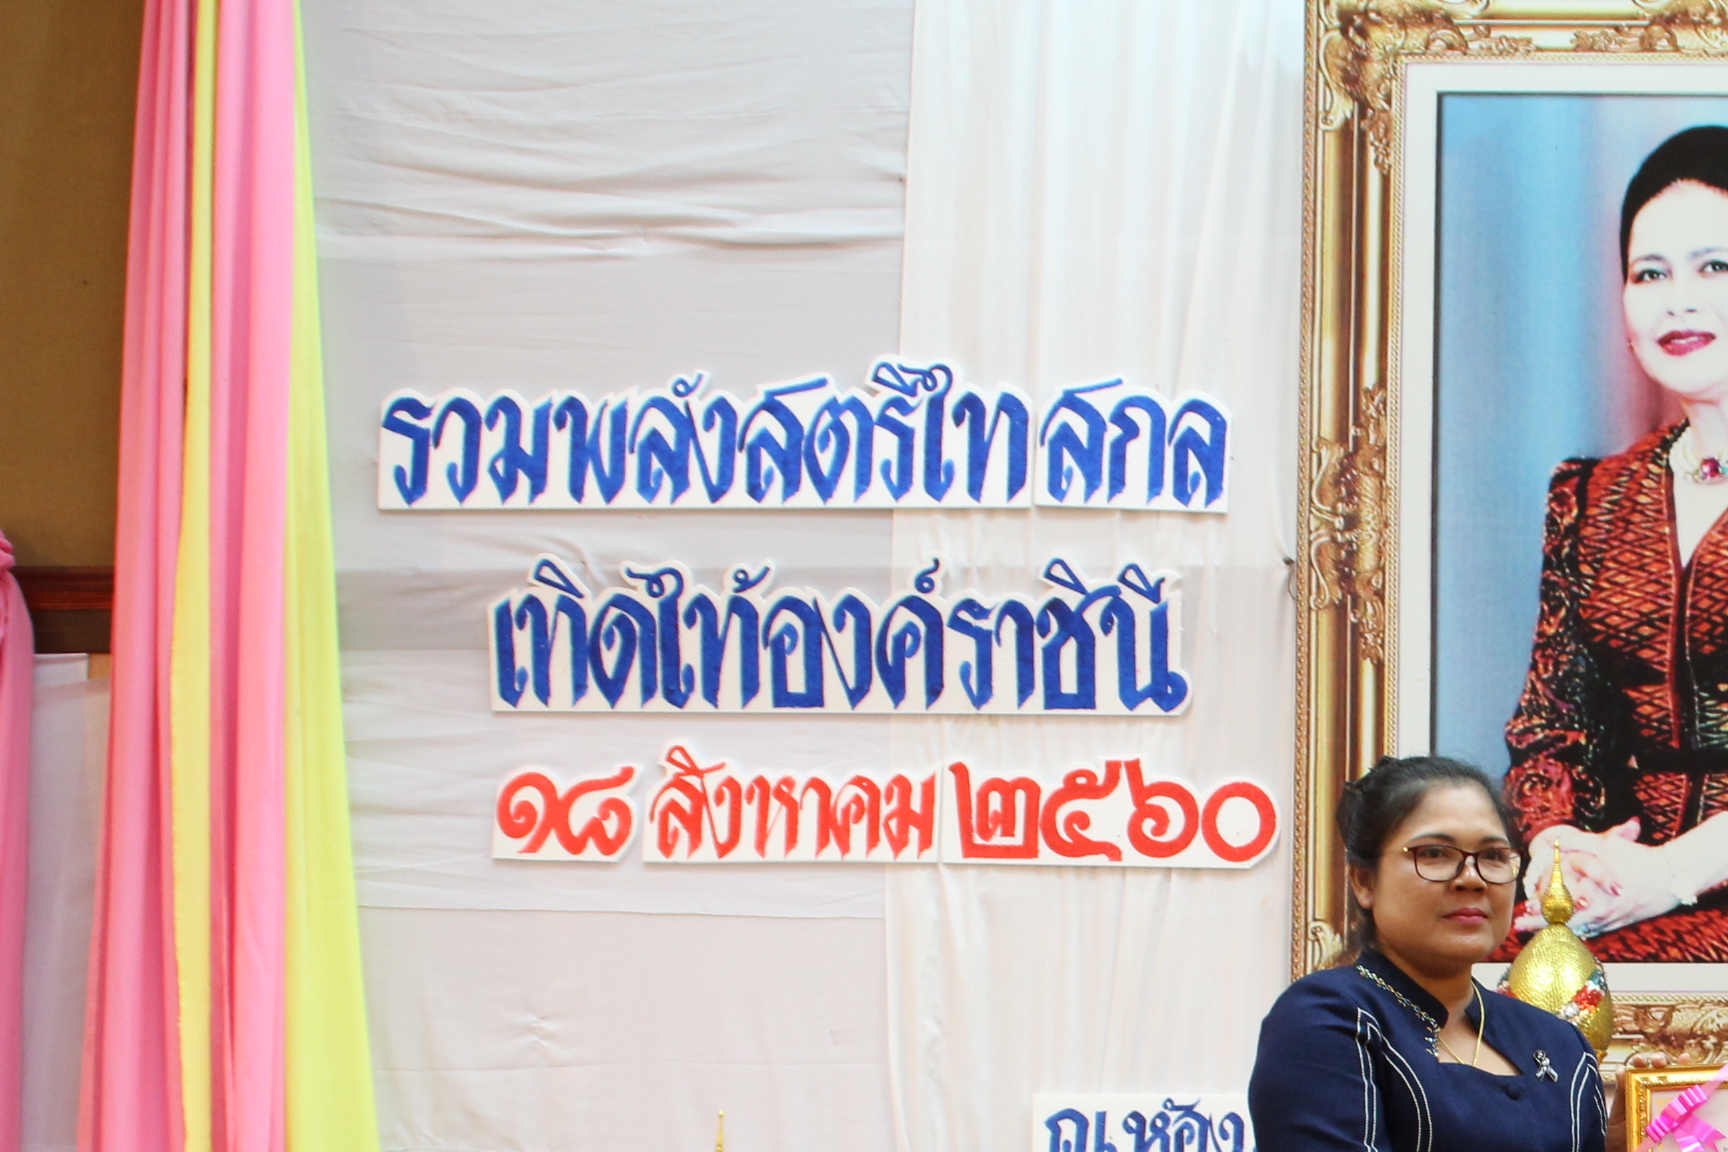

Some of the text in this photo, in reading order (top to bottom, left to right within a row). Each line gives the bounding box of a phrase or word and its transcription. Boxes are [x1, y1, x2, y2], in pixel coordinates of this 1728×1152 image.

[649, 745, 937, 859] สิงหาคม
[949, 758, 1278, 863] ๒๕๖๐
